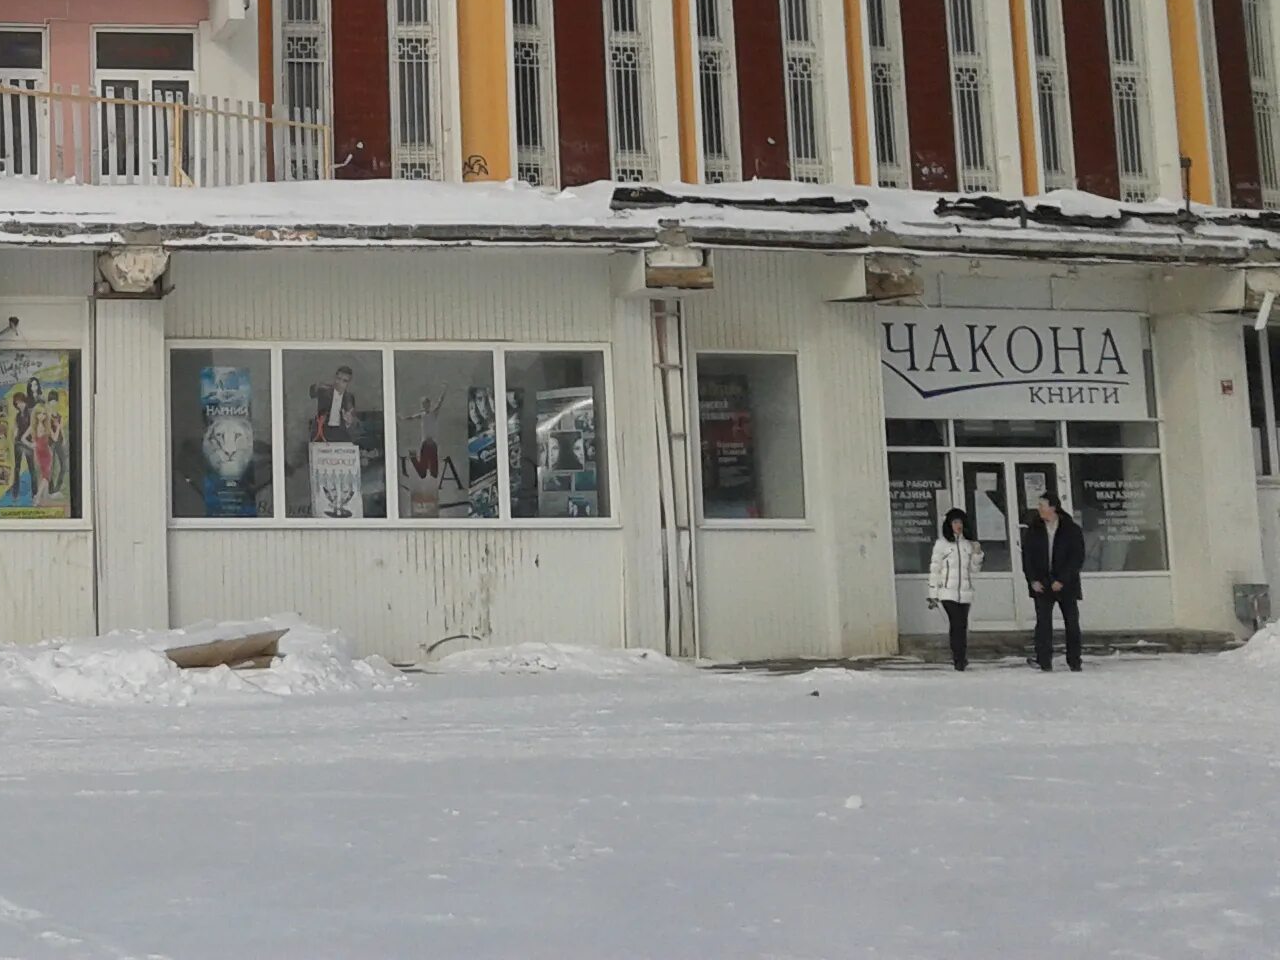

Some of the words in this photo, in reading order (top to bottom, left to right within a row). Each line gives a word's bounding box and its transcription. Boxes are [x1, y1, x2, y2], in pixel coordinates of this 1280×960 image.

[881, 322, 1129, 378] ЧАКОНА
[1029, 386, 1120, 405] КНИГИ
[890, 490, 932, 499] АГАЗИНА
